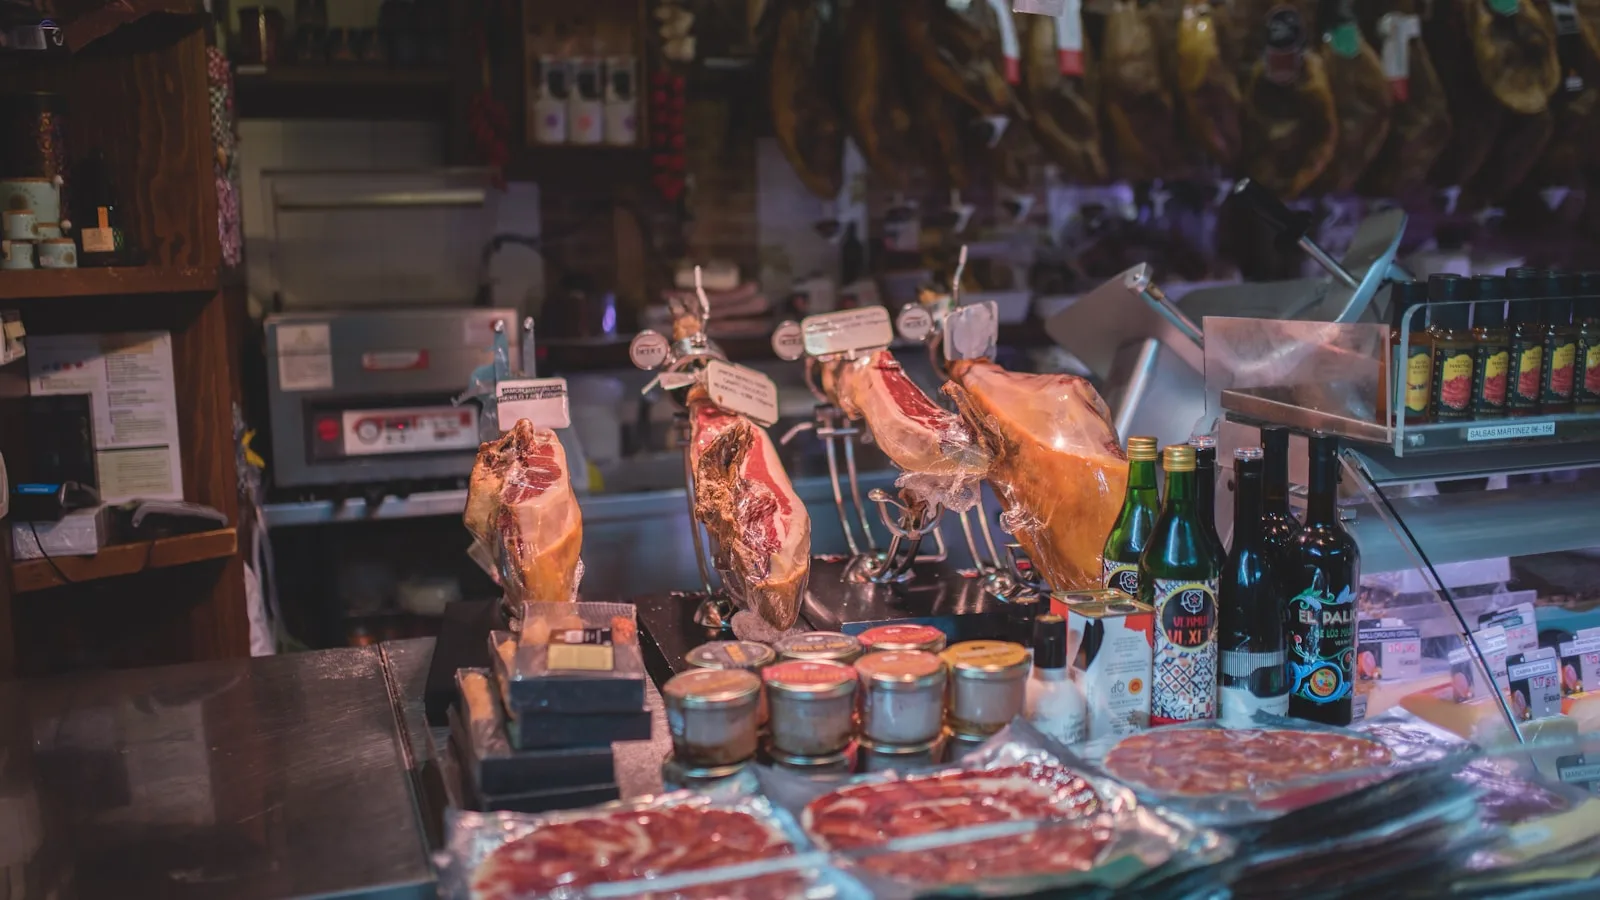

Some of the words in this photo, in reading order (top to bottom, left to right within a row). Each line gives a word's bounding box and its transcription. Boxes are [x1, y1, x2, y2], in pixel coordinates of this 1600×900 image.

[1470, 429, 1496, 438] SALSAS
[1497, 426, 1530, 437] MARTINEZ
[1299, 609, 1319, 625] EL
